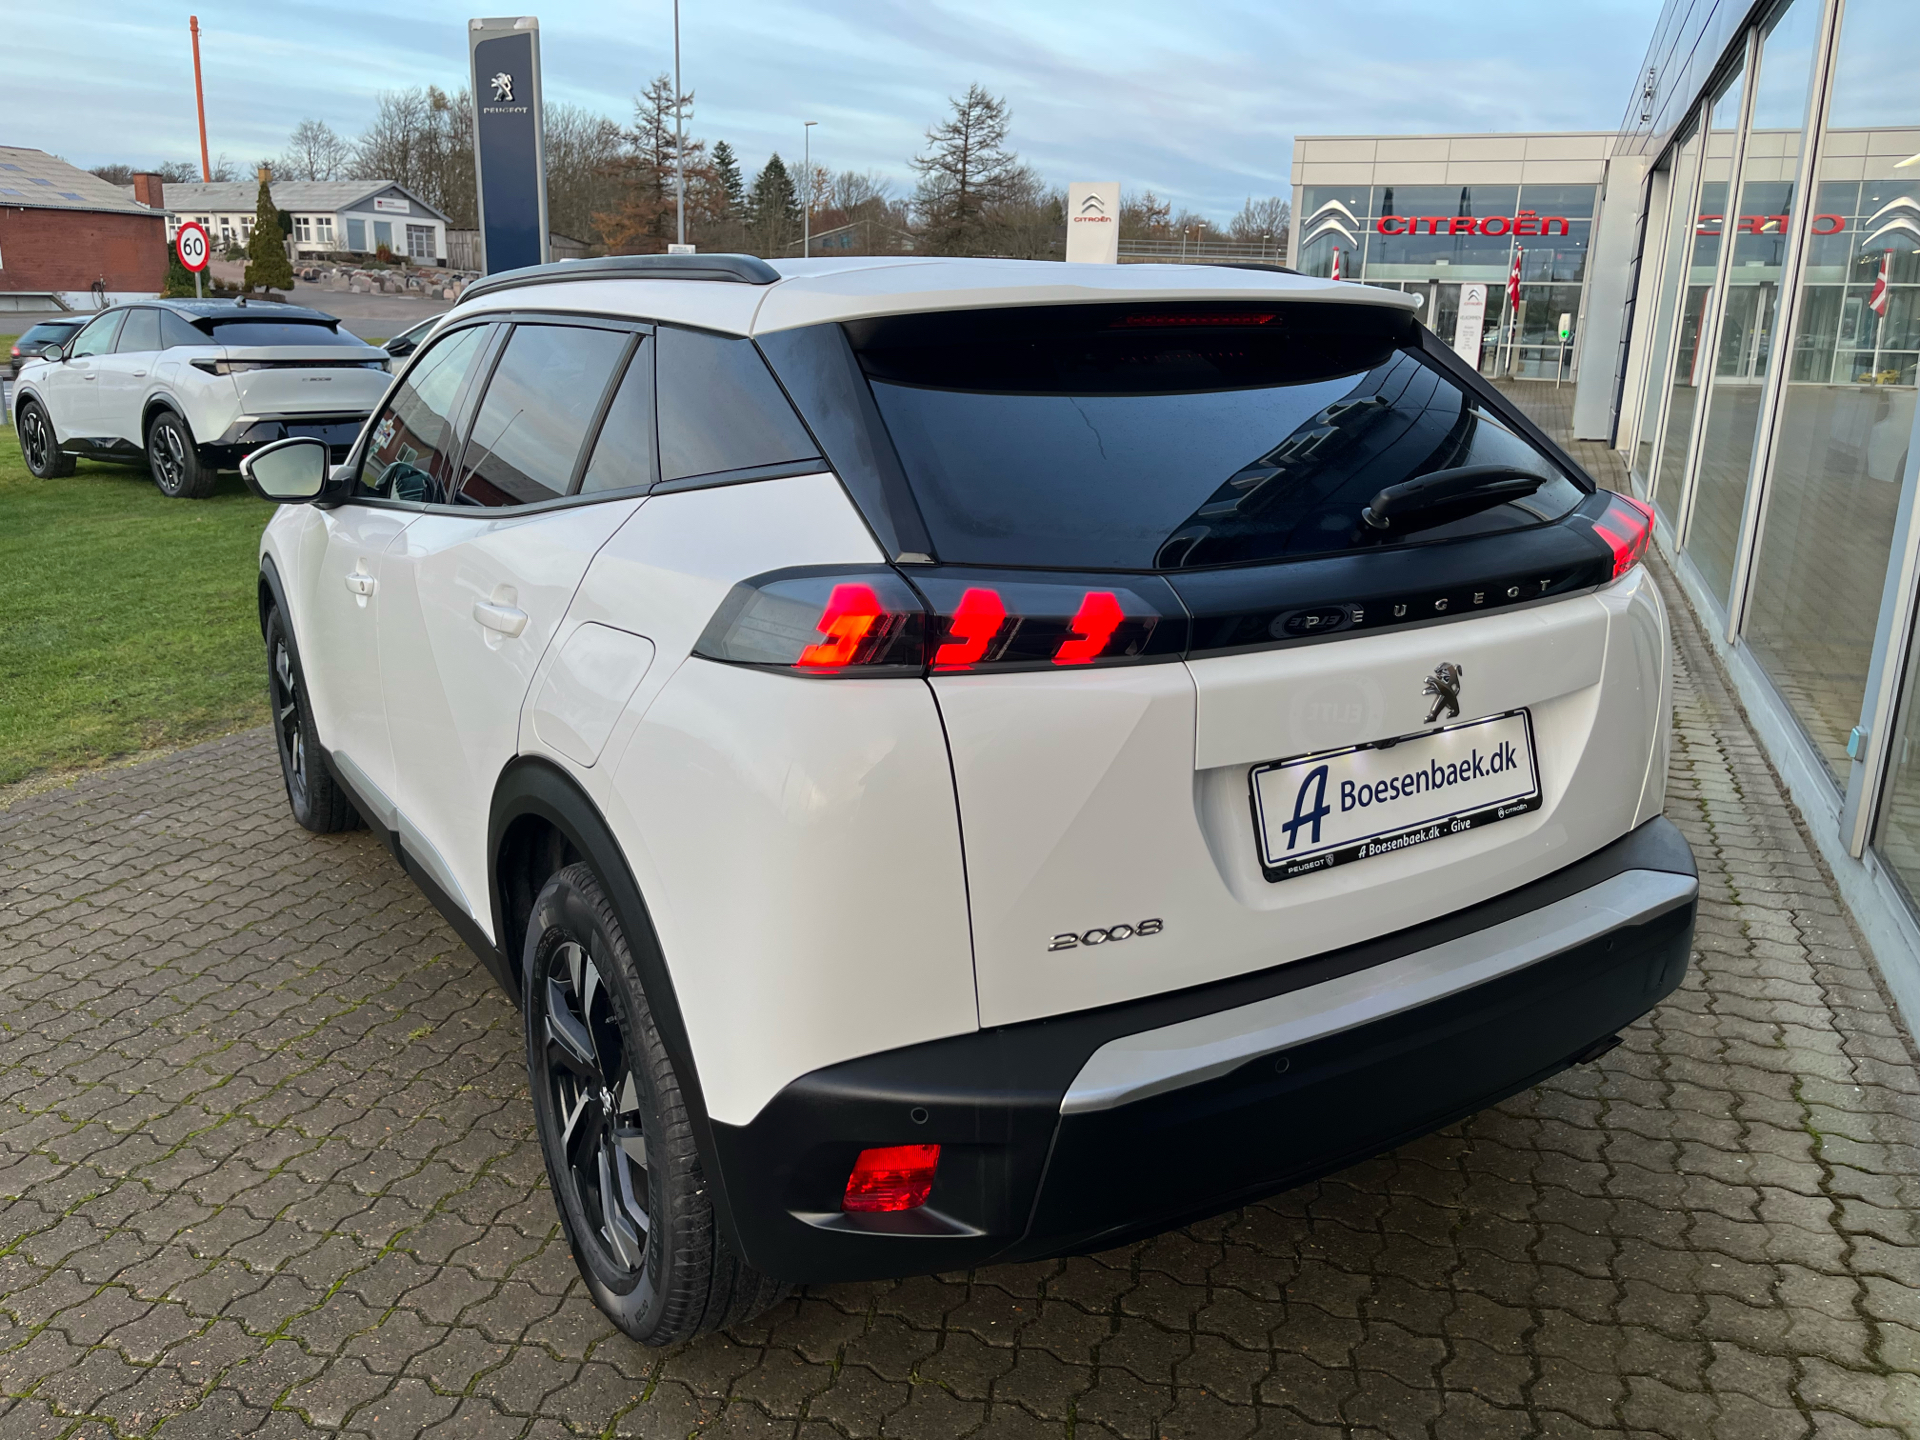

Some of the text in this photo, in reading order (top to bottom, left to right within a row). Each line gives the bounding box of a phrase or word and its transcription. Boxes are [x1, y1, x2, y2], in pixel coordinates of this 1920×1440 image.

[483, 106, 528, 114] PEUGEOT
[1377, 210, 1569, 236] CITROËN
[183, 237, 203, 256] 60
[1306, 579, 1550, 628] PEUGEOT
[1341, 741, 1517, 812] Boesenbaek.dk
[1288, 859, 1325, 874] PEUGEOT
[1369, 826, 1440, 856] Boesenbaek.dk
[1451, 820, 1471, 832] Give
[1047, 918, 1163, 951] 2008
